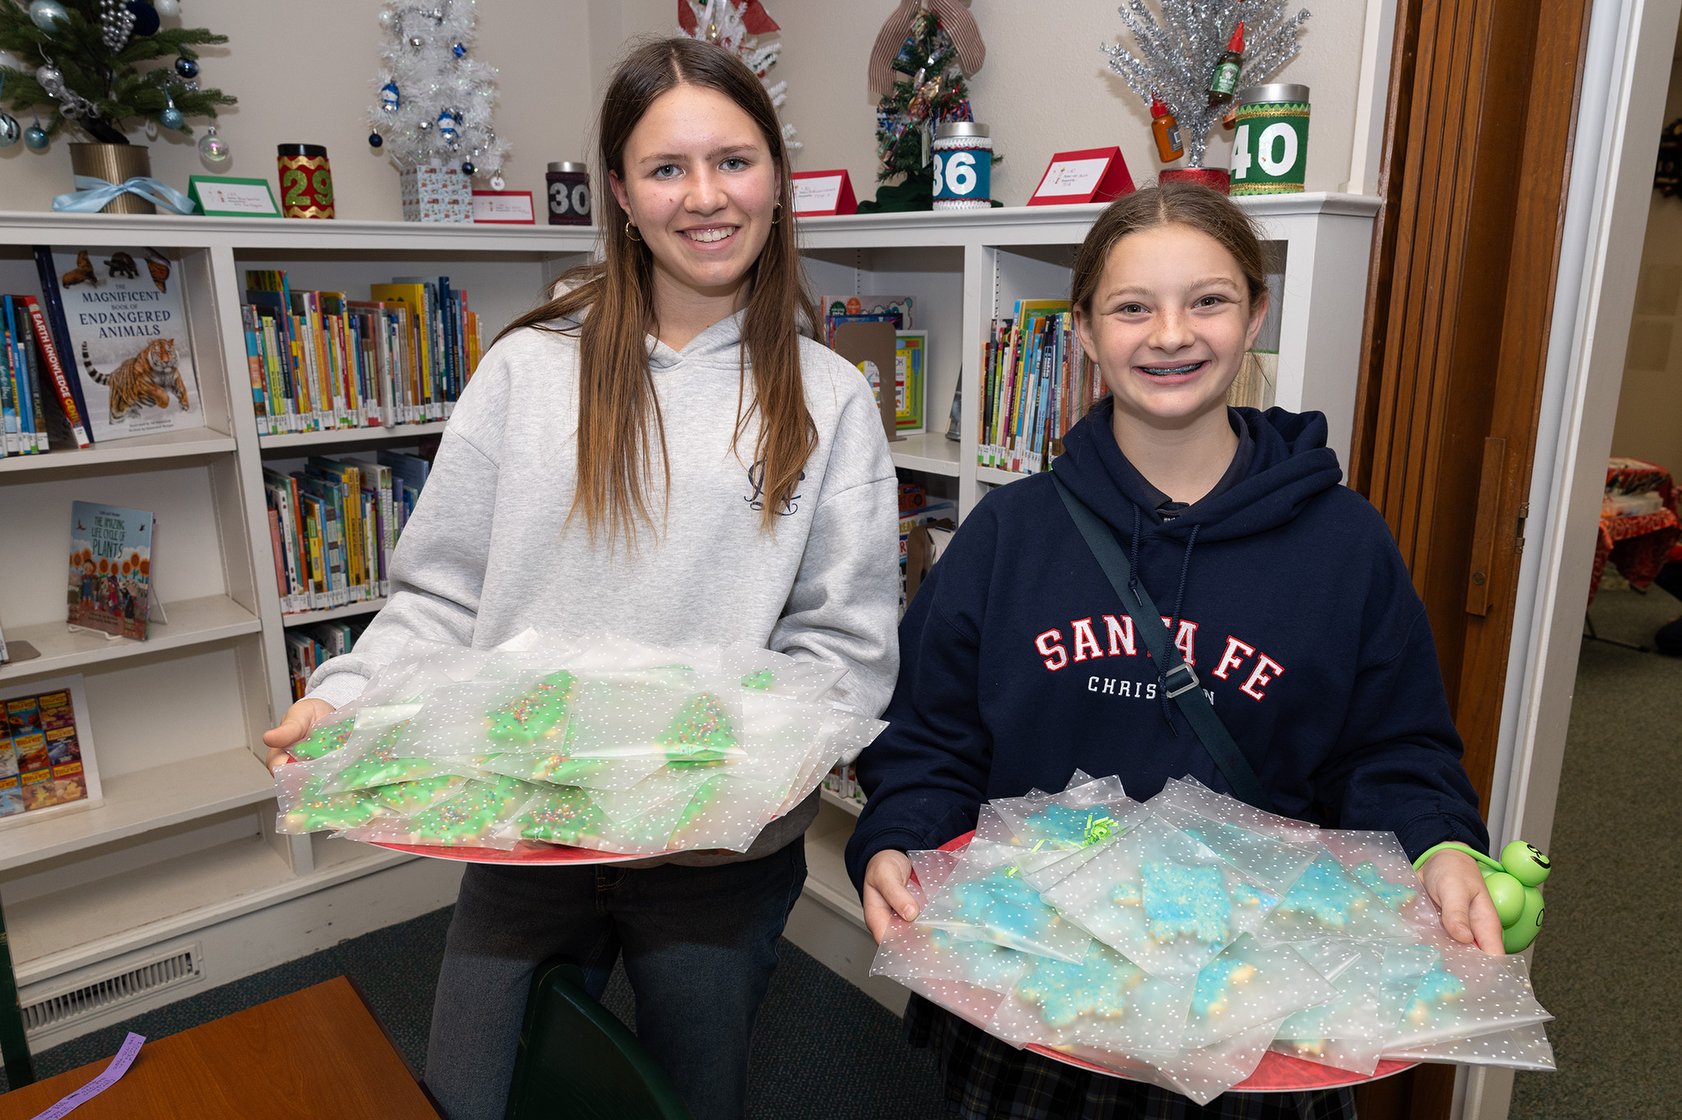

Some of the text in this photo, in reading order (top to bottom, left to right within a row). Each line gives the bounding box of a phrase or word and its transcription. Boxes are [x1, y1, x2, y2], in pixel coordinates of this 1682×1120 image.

[1230, 122, 1298, 180] 40
[283, 169, 333, 206] 29
[933, 152, 977, 197] 36
[549, 182, 591, 216] 30
[82, 291, 159, 303] MAGNIFICENT
[79, 310, 171, 325] ENDANGERED
[99, 324, 161, 338] ANIMALS
[33, 313, 50, 342] EARTH
[44, 342, 71, 398] KNOWLEDGE
[92, 527, 102, 539] LIFE
[103, 529, 117, 541] CYCLE
[104, 518, 125, 531] AMAZING
[92, 538, 123, 559] PLANTS
[1034, 614, 1285, 701] SANA FE
[1088, 676, 1215, 705] CHRISN
